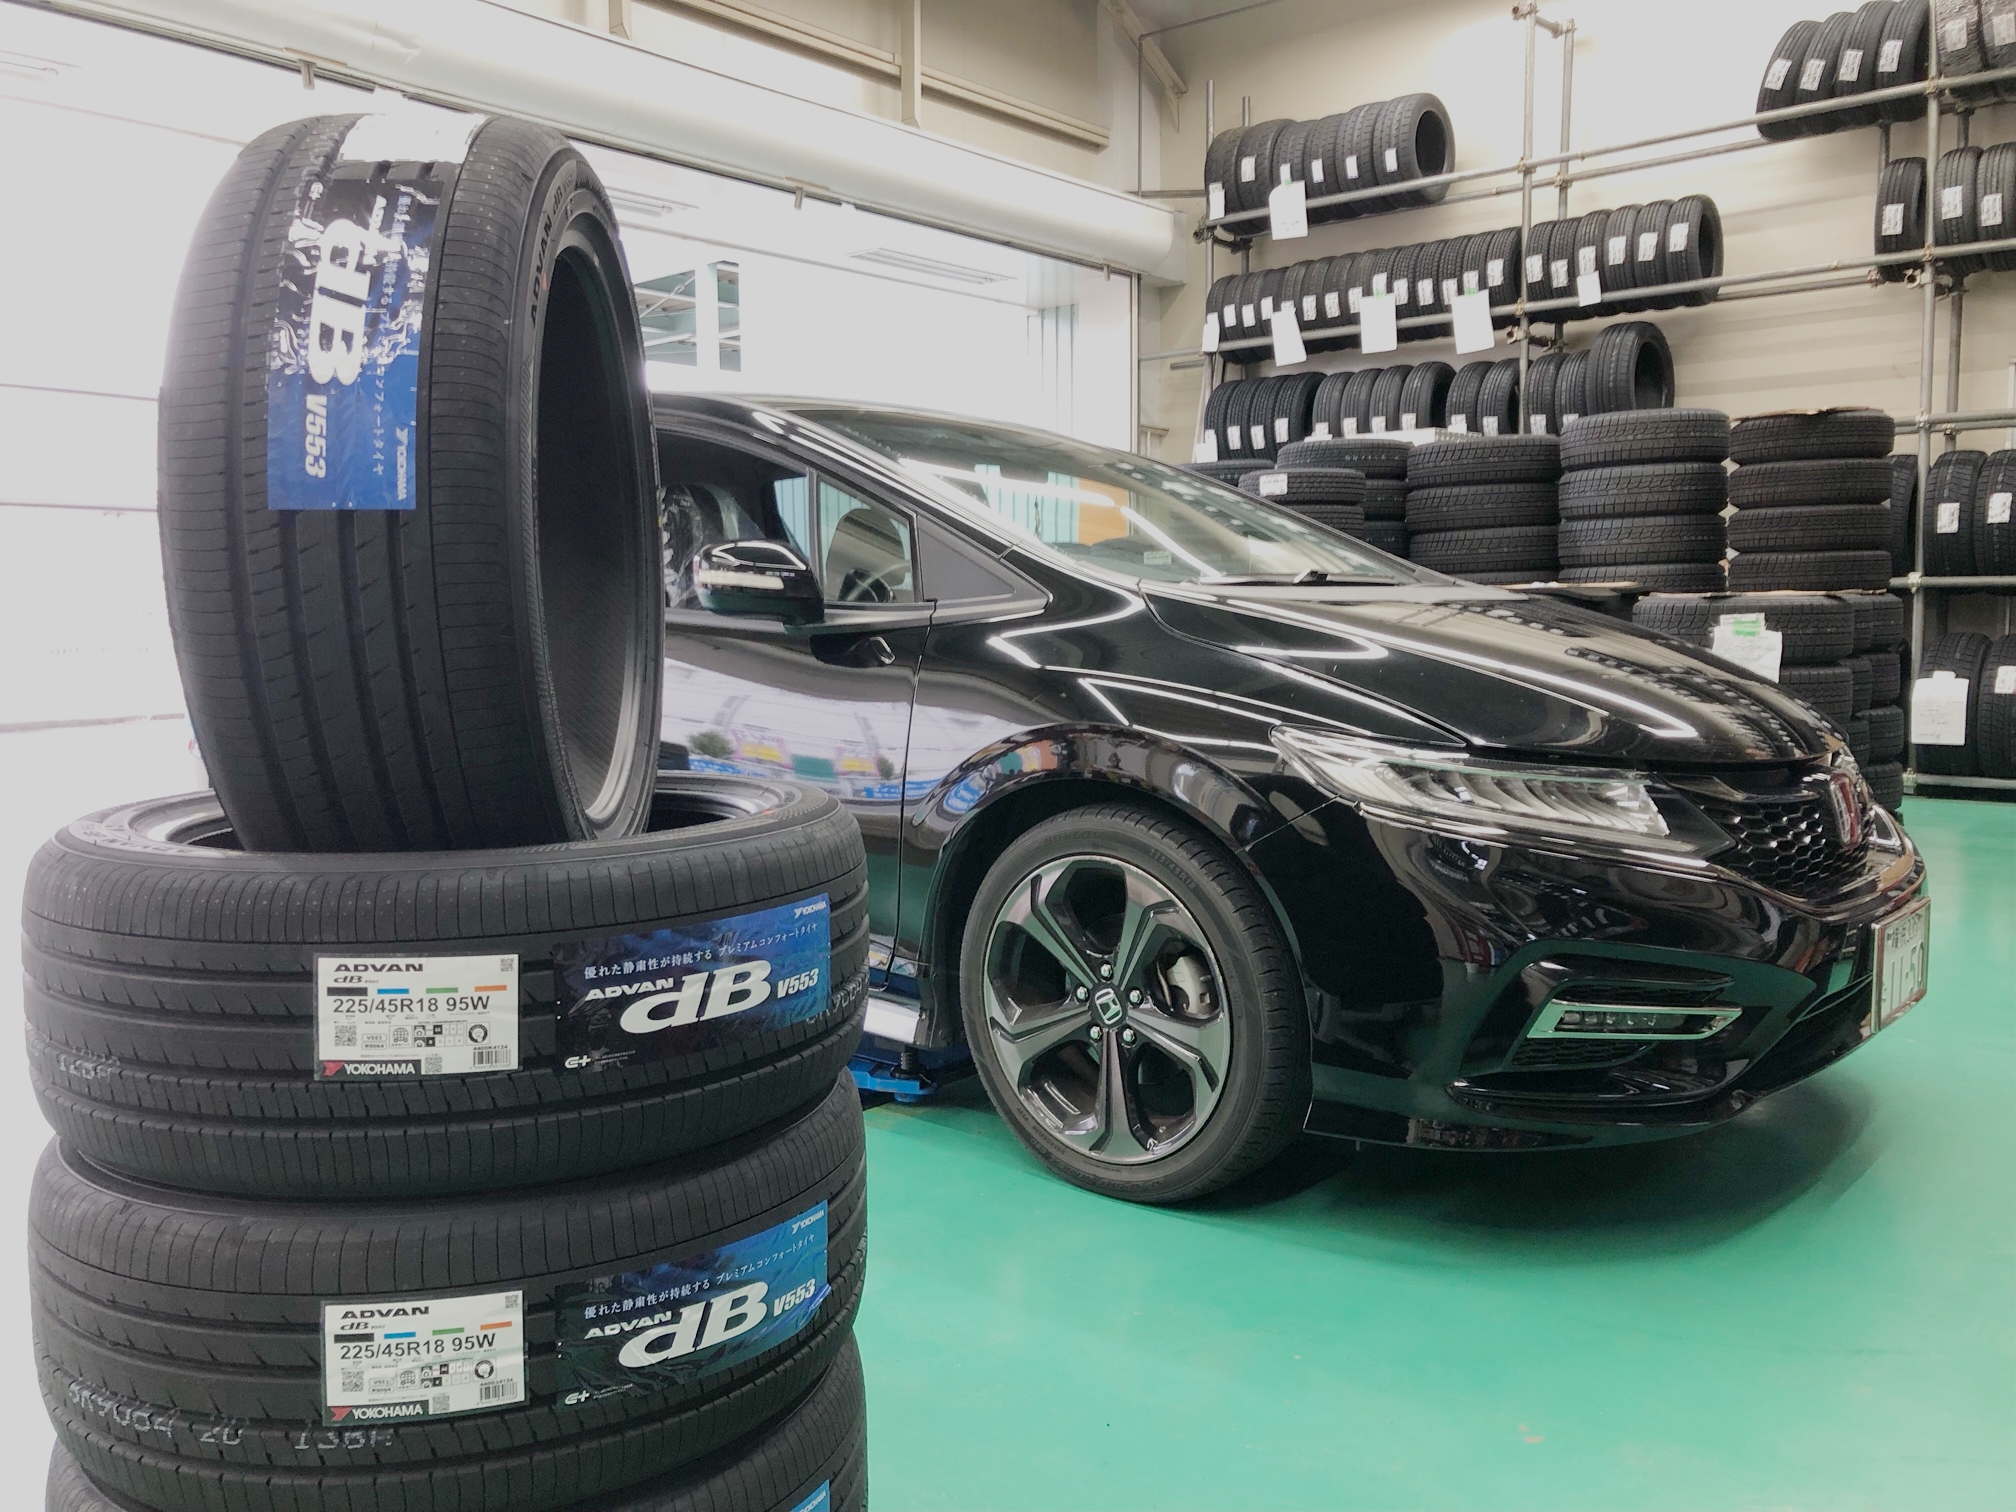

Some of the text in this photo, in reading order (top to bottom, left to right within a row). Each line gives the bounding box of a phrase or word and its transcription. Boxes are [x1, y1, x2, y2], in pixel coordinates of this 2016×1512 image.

[530, 214, 553, 328] ADVAN
[309, 218, 372, 386] dB
[305, 393, 328, 479] V553
[396, 444, 408, 500] YOKOHAMA
[334, 964, 424, 973] ADVAN
[584, 922, 818, 980] 優れた静粛性が持続する プレミアムコンフォートタイヤ
[333, 995, 490, 1014] 225/45R18 95W
[584, 960, 819, 1034] ADVAN dB V553
[344, 1063, 415, 1075] YOKOHAMA
[584, 1233, 815, 1320] 優れた静粛性が持続する プレミアムコンフォートタイヤ
[340, 1322, 369, 1331] dB
[341, 1306, 429, 1319] ADVAN
[584, 1278, 816, 1368] ADVAN dB V553
[340, 1333, 496, 1360] 225/45R18 95W
[352, 1404, 424, 1420] YOKOHAMA
